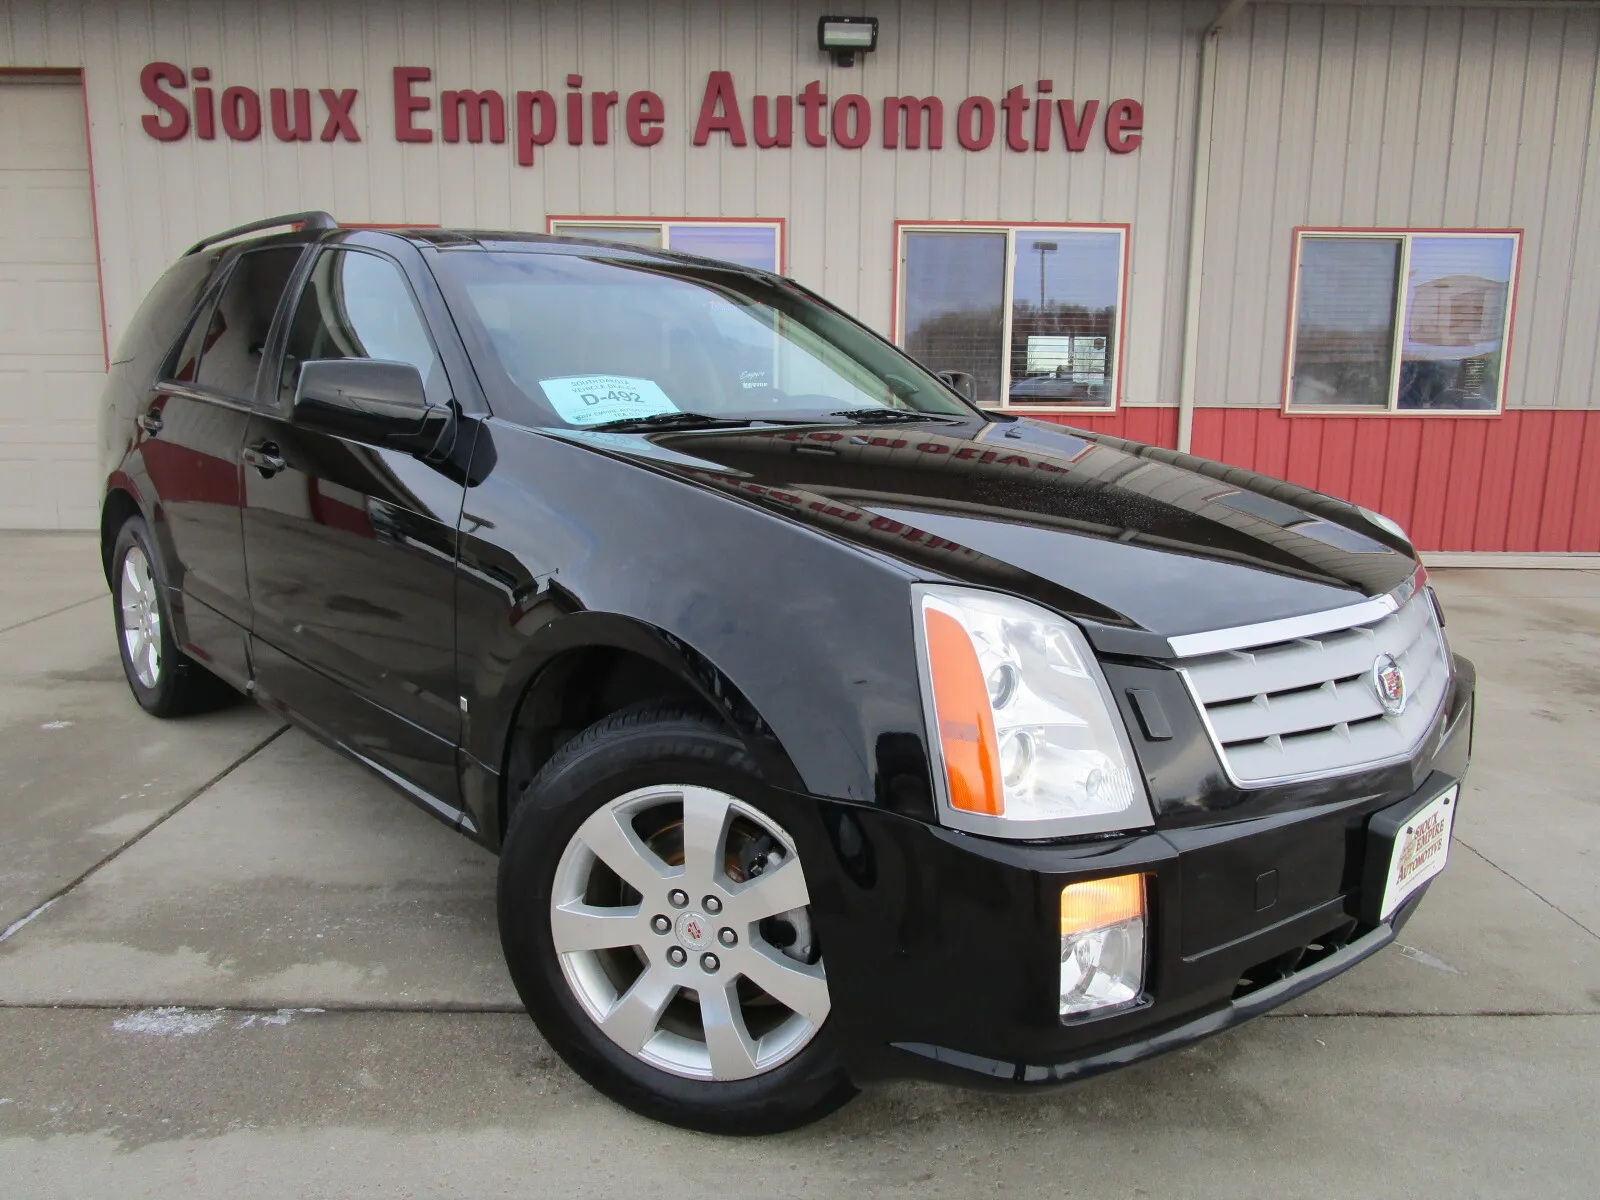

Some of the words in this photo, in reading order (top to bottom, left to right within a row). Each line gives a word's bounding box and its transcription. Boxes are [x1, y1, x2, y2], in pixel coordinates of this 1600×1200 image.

[140, 62, 361, 142] Sioux
[393, 66, 666, 167] Empire
[693, 71, 1144, 154] Automotive
[572, 384, 605, 393] VEHICLE
[580, 390, 645, 406] D-492
[1414, 812, 1439, 839] SIOUX
[1416, 819, 1445, 852] EMPIRE
[1397, 838, 1443, 882] AUTOMOTIVE
